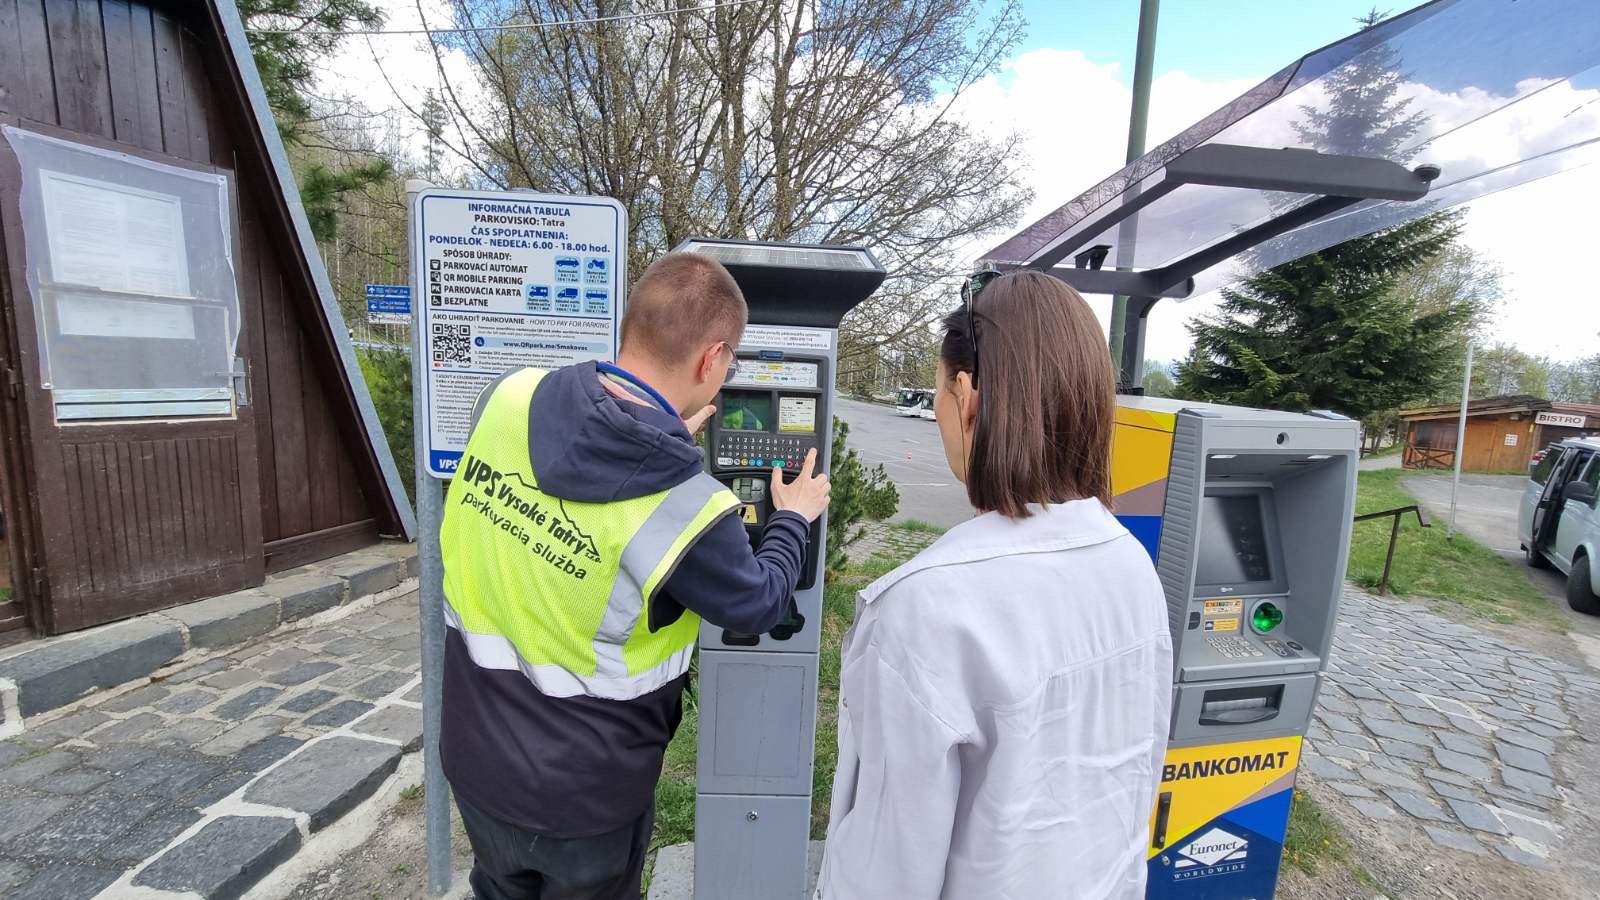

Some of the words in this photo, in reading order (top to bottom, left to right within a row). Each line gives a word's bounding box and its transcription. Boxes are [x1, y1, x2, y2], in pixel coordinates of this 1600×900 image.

[468, 203, 532, 215] INFORMAČNÁ
[534, 206, 571, 217] TABUĽA
[474, 214, 540, 226] PARKOVISKO:
[541, 218, 566, 228] Tatra
[471, 225, 490, 236] ČAS
[492, 228, 569, 240] SPOPLATNENIA:
[429, 235, 482, 246] PONDELOK
[490, 238, 531, 248] NEDEĽA:
[532, 240, 554, 250] 6.00
[562, 242, 588, 252] 18.00
[589, 243, 610, 253] hod.
[442, 248, 475, 259] SPÔSOB
[476, 250, 512, 261] ÚHRADY:
[443, 260, 488, 272] PARKOVACÍ
[490, 264, 528, 274] AUTOMAT
[444, 274, 455, 282] QR
[456, 274, 487, 284] MOBILE
[488, 276, 524, 286] PARKING
[444, 285, 494, 296] PARKOVACIA
[496, 288, 522, 297] KARTA
[444, 296, 489, 307] BEZPLATNE
[482, 316, 525, 325] PARKOVANIE
[583, 321, 610, 330] PARKING
[1539, 414, 1581, 424] BISTRO
[439, 458, 458, 470] VPS
[463, 455, 503, 498] VPS
[497, 483, 548, 526] Vysoké
[547, 517, 588, 556] Tatry
[532, 541, 588, 580] služba
[1162, 752, 1288, 782] BANKOMAT
[1188, 840, 1238, 856] Euronet
[1174, 864, 1246, 879] WORLDWIDE
